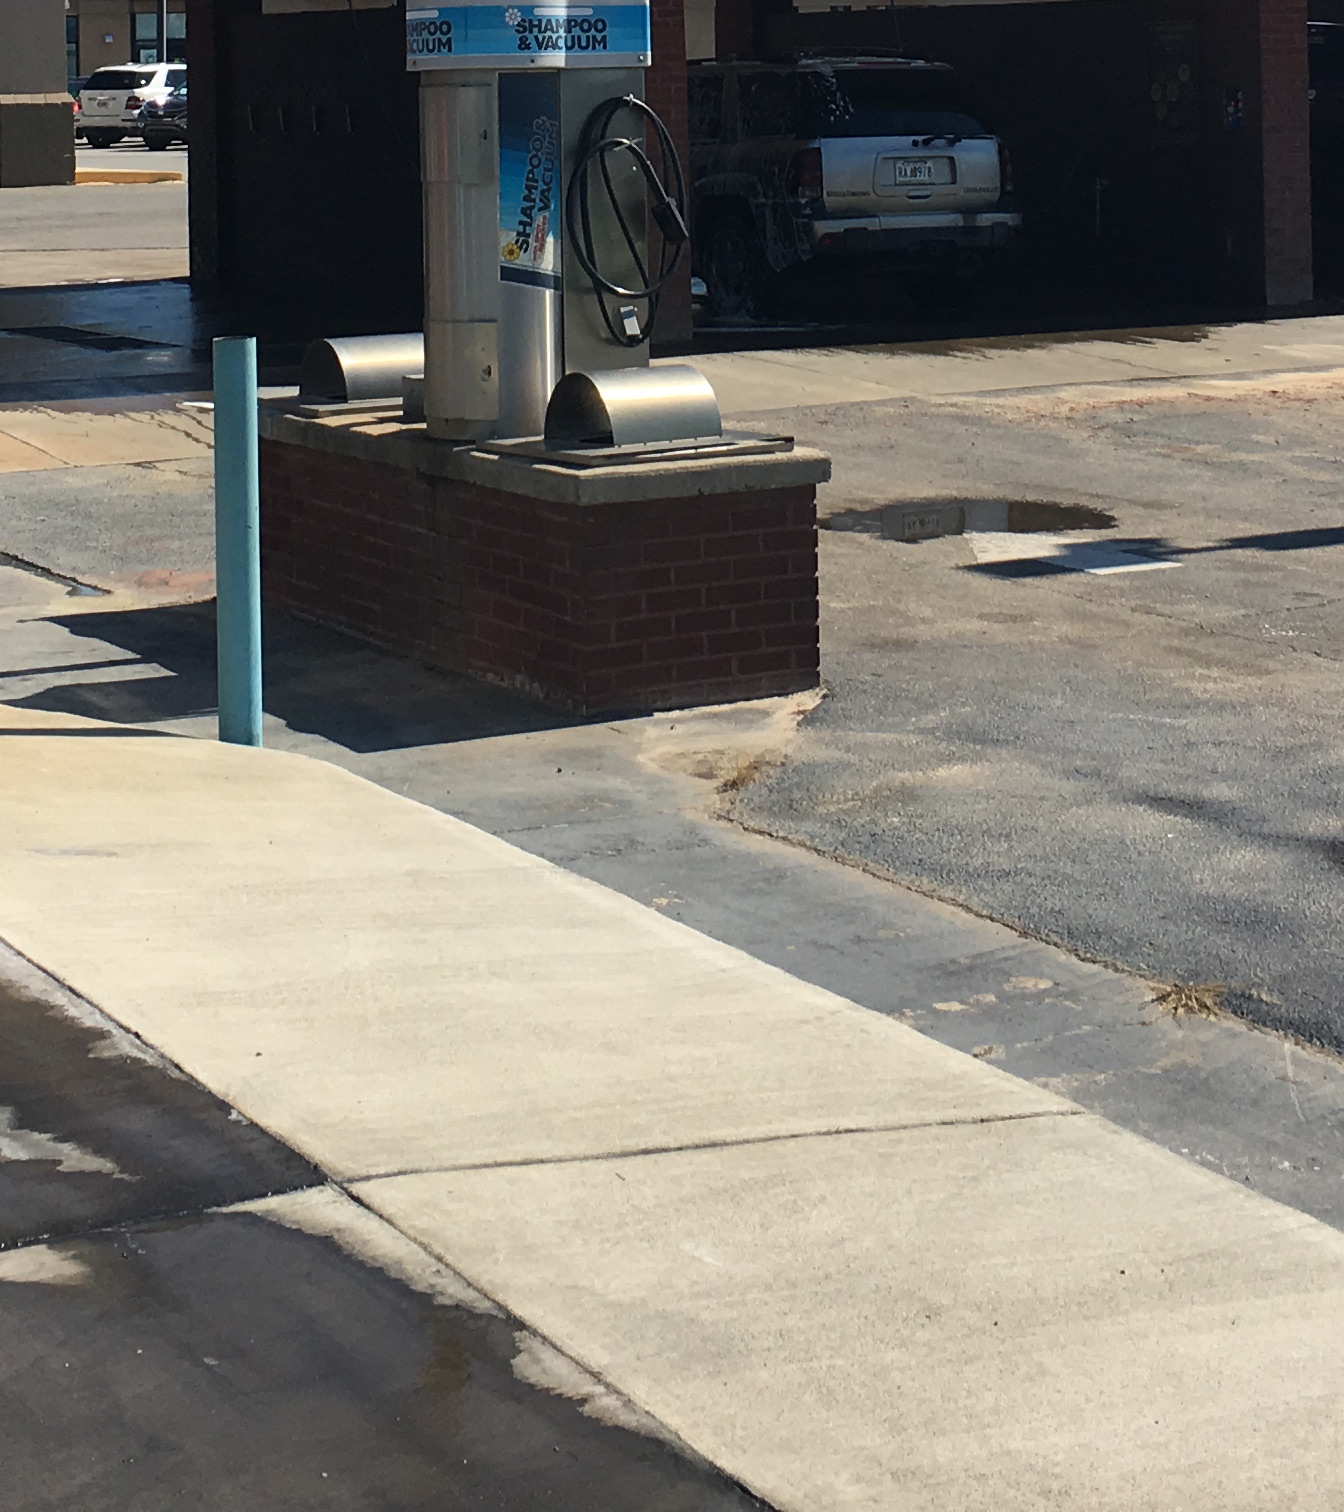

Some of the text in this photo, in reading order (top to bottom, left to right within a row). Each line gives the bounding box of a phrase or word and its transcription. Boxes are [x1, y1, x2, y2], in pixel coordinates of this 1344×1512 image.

[514, 18, 608, 34] SHAMPOO
[517, 35, 608, 51] & VACUUM
[536, 118, 559, 213] VACUUM
[514, 136, 544, 254] SHAMPOO
